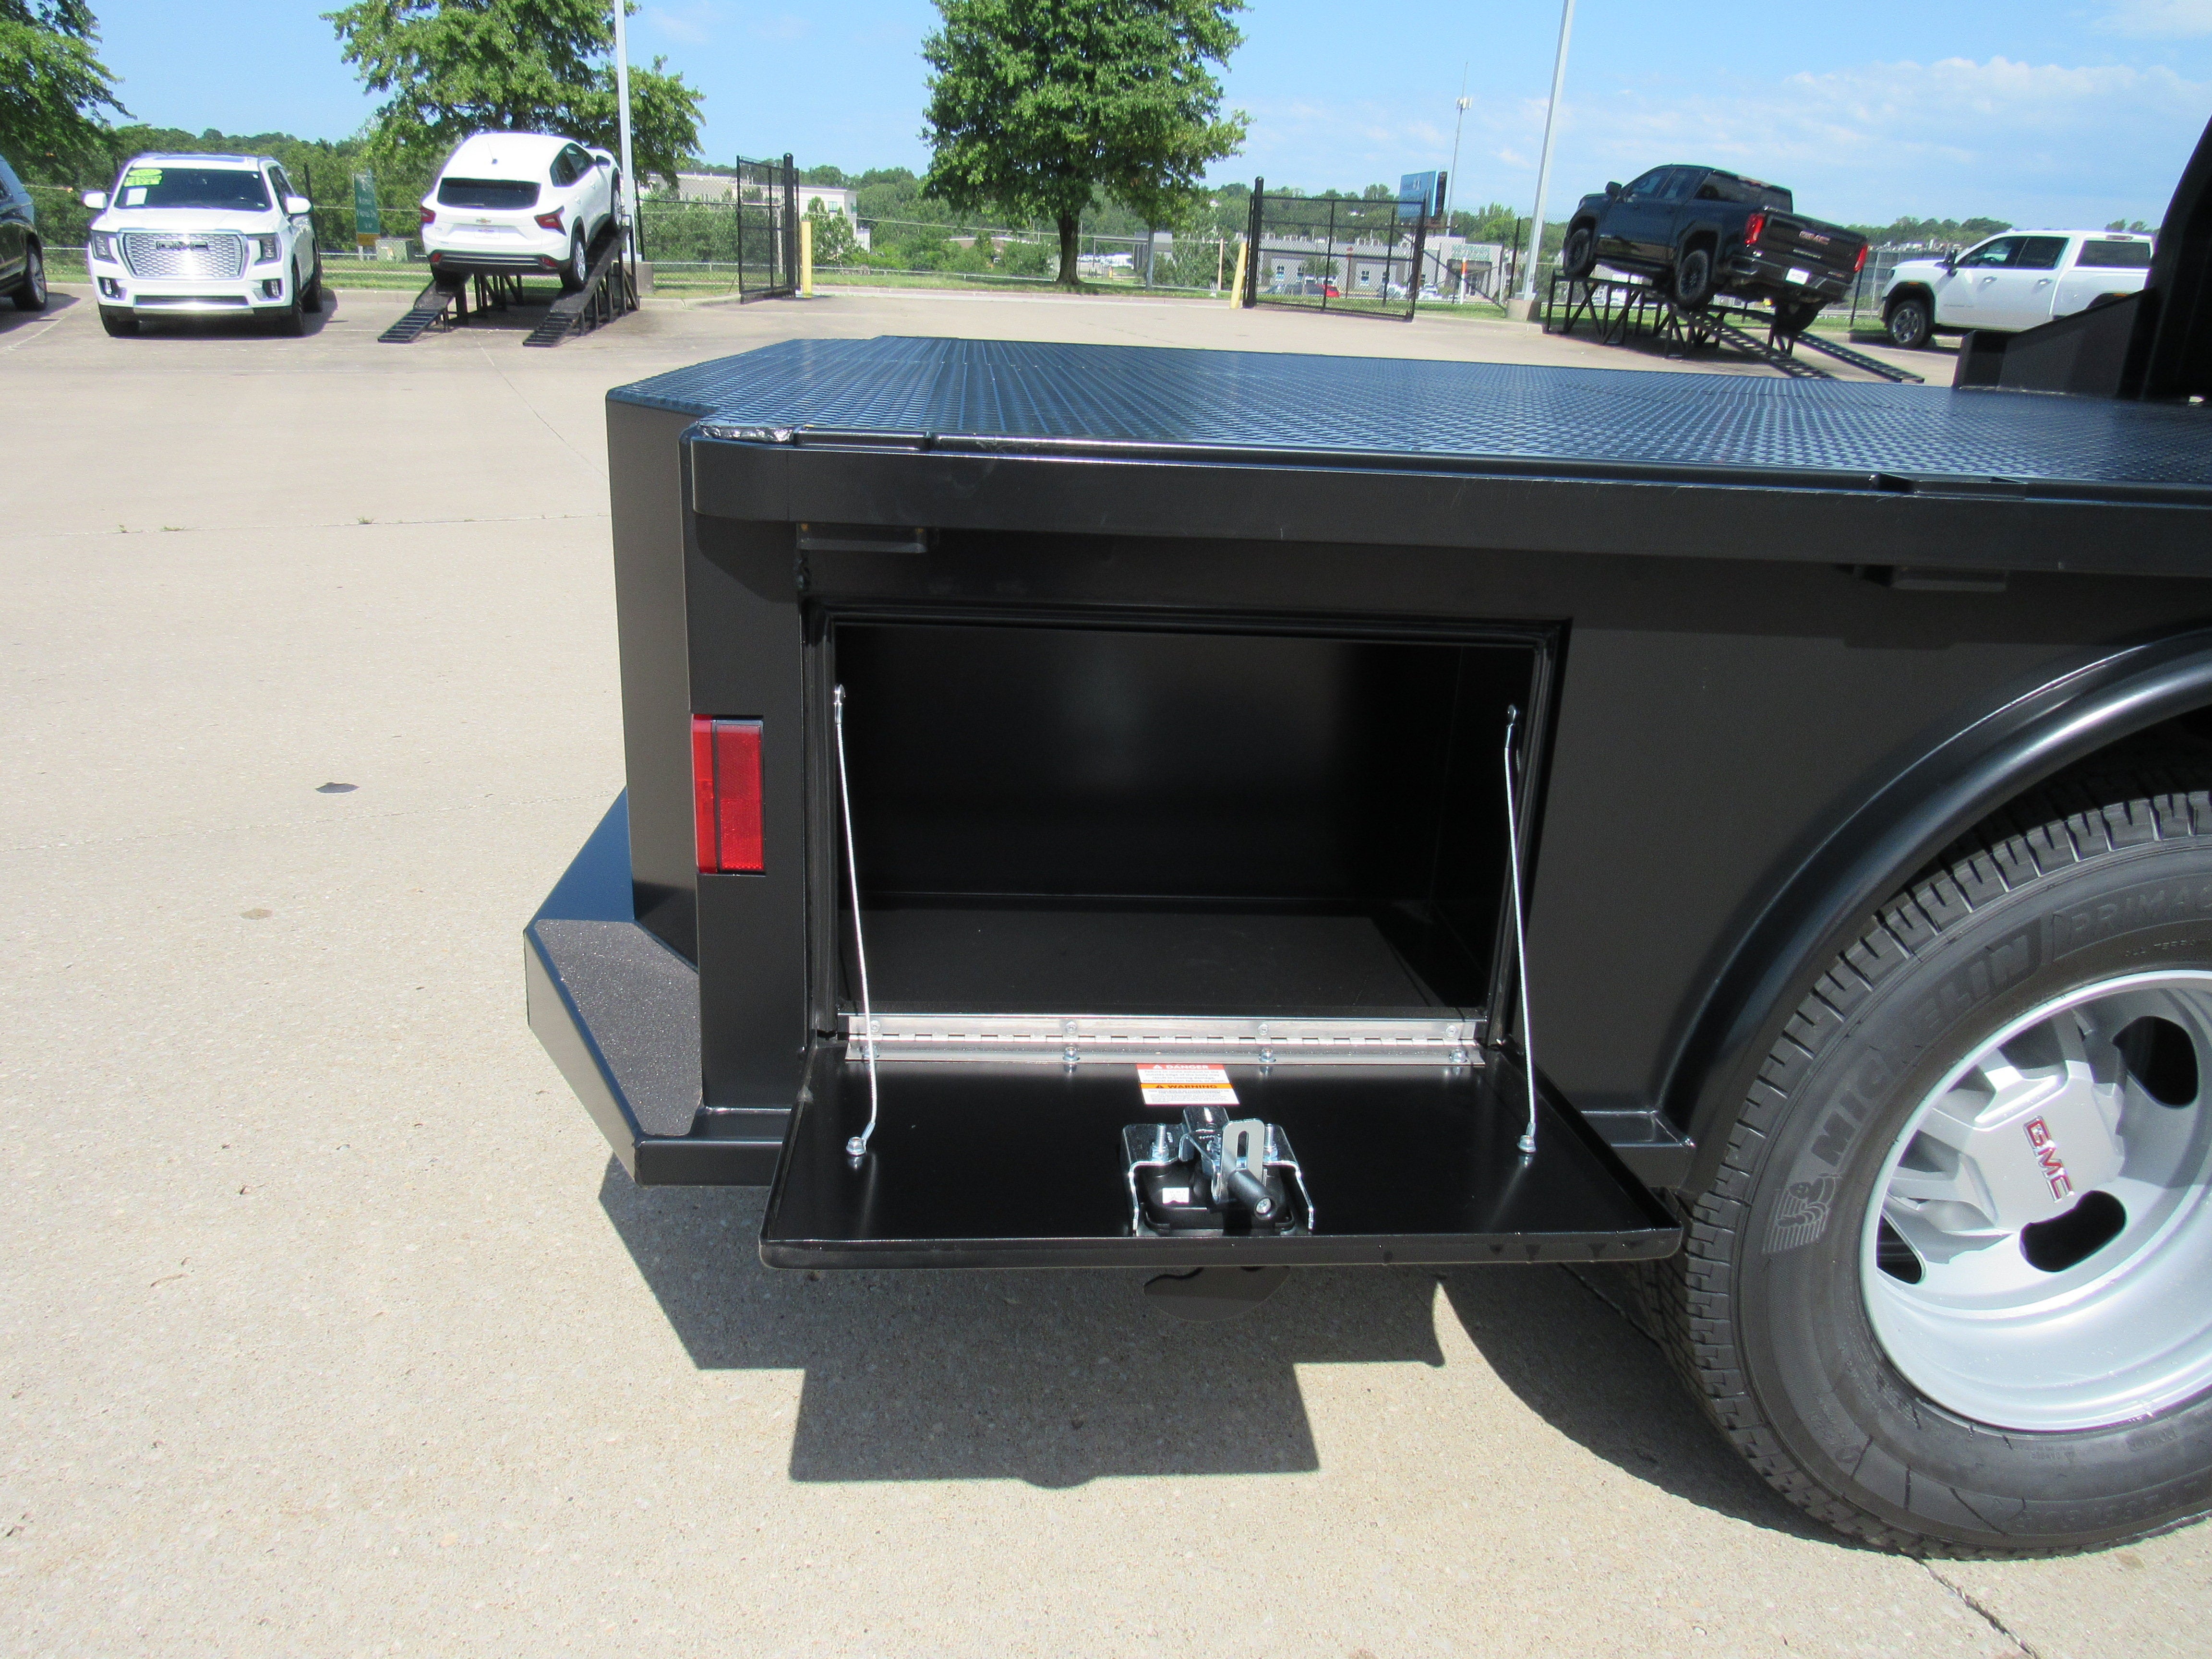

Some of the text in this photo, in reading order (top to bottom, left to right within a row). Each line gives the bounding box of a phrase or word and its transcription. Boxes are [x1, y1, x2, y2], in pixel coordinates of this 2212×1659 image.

[156, 241, 209, 251] GMC
[1799, 230, 1830, 245] GMC
[1810, 934, 2030, 1167] MICELIN
[2022, 1115, 2076, 1203] GMC
